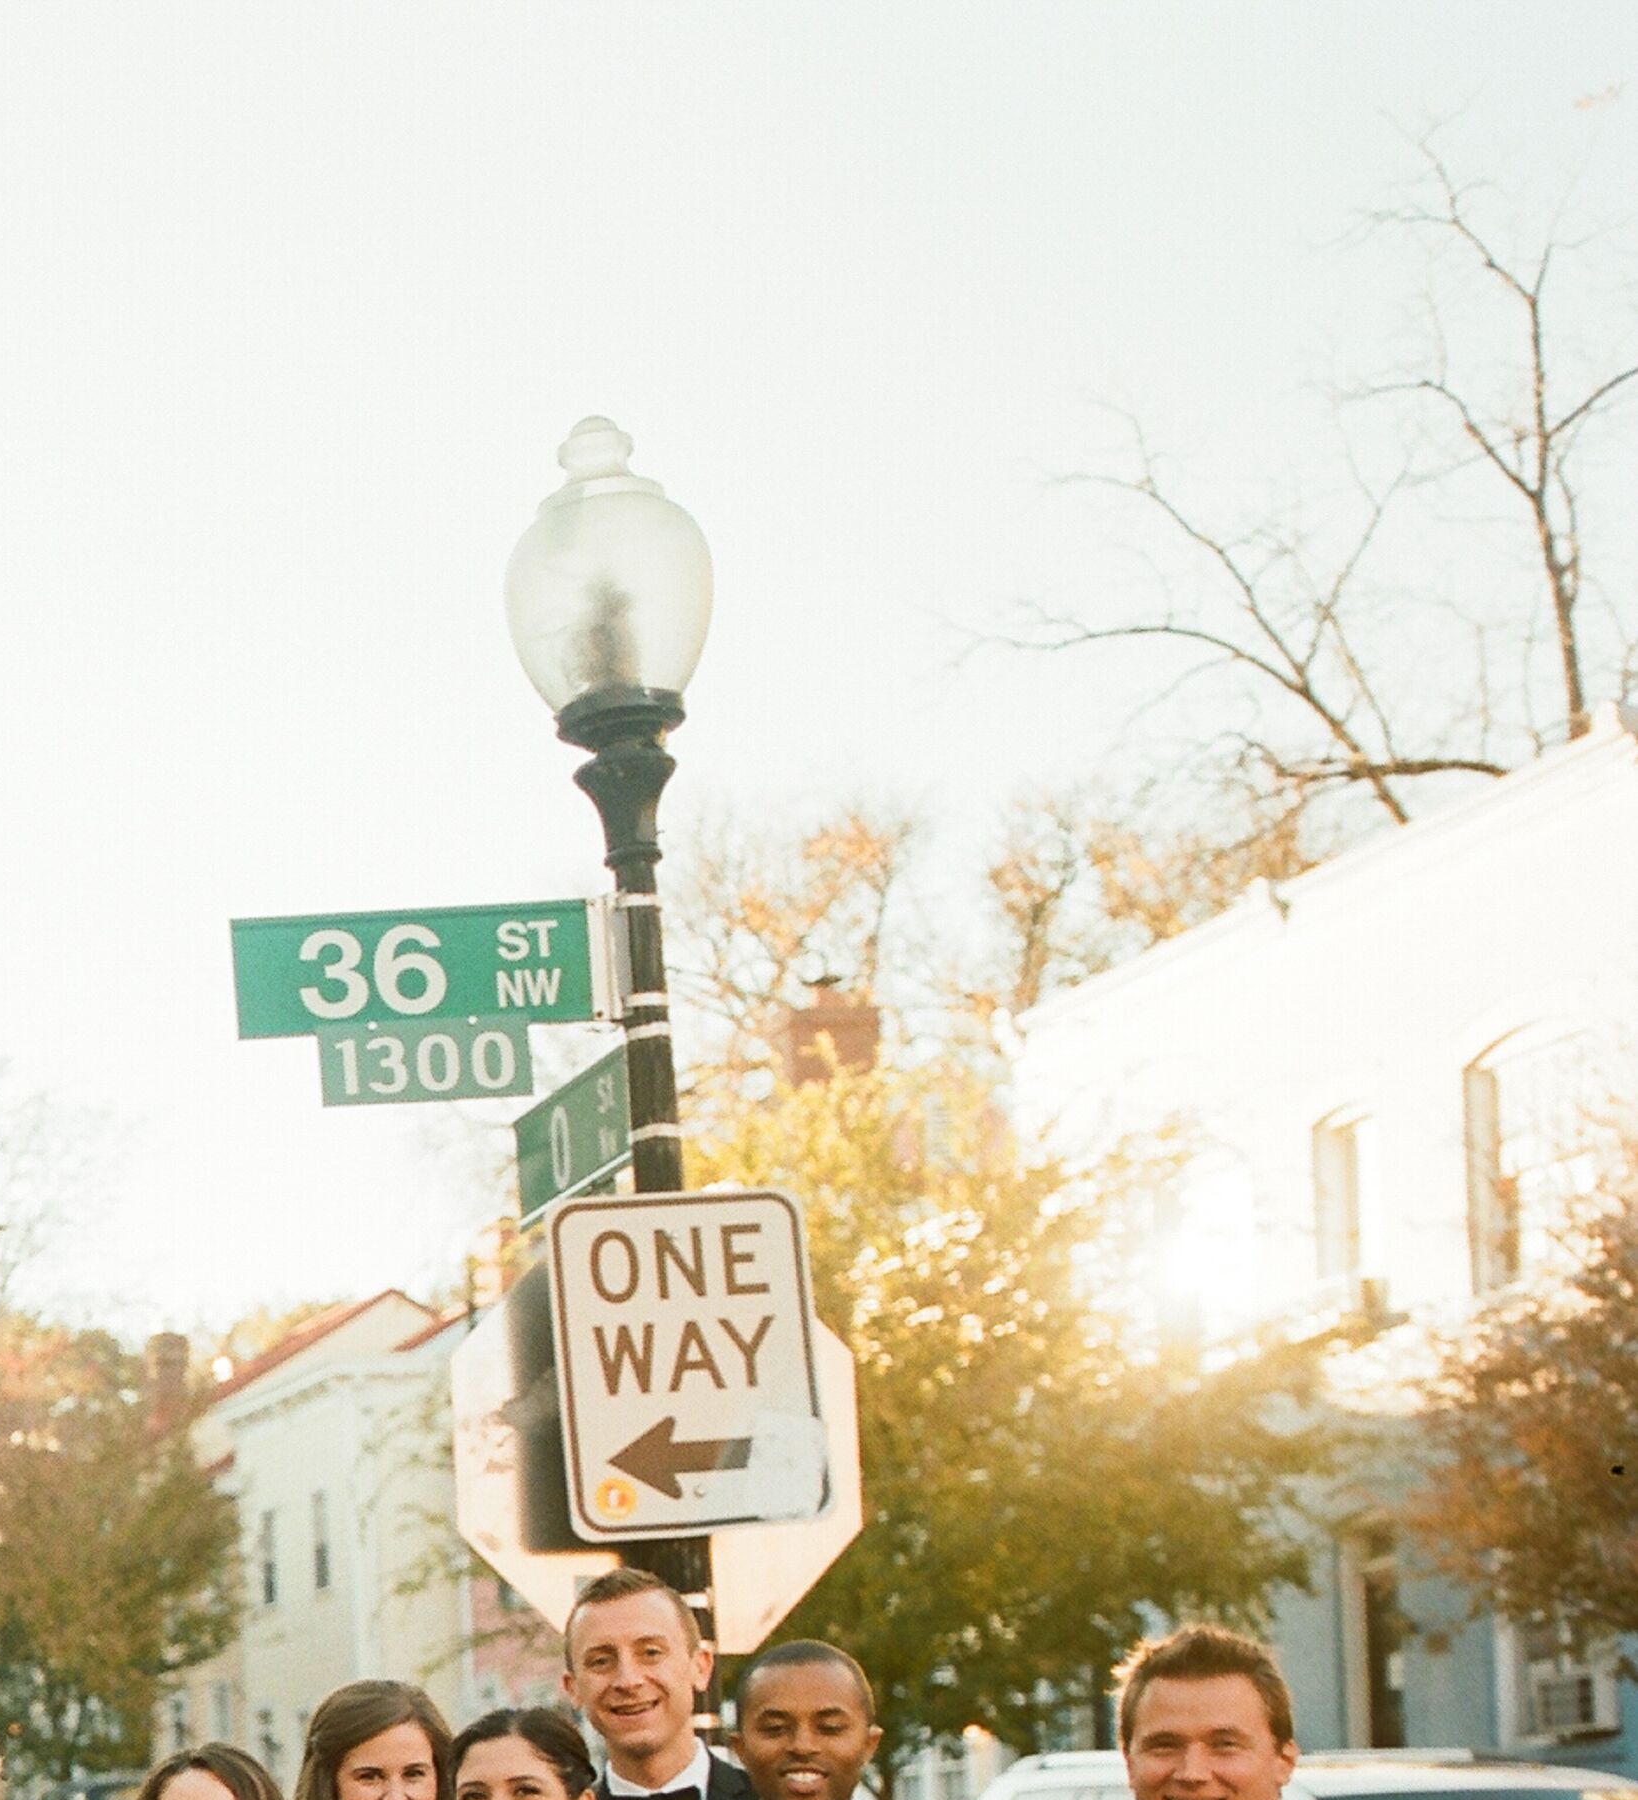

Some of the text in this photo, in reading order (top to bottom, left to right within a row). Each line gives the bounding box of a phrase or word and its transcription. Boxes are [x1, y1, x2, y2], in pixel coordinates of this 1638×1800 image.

[298, 924, 448, 1019] 36
[496, 920, 558, 958] ST
[495, 969, 561, 1007] NW
[333, 1030, 516, 1096] 1300
[589, 1222, 771, 1303] ONE
[592, 1314, 775, 1397] WAY
